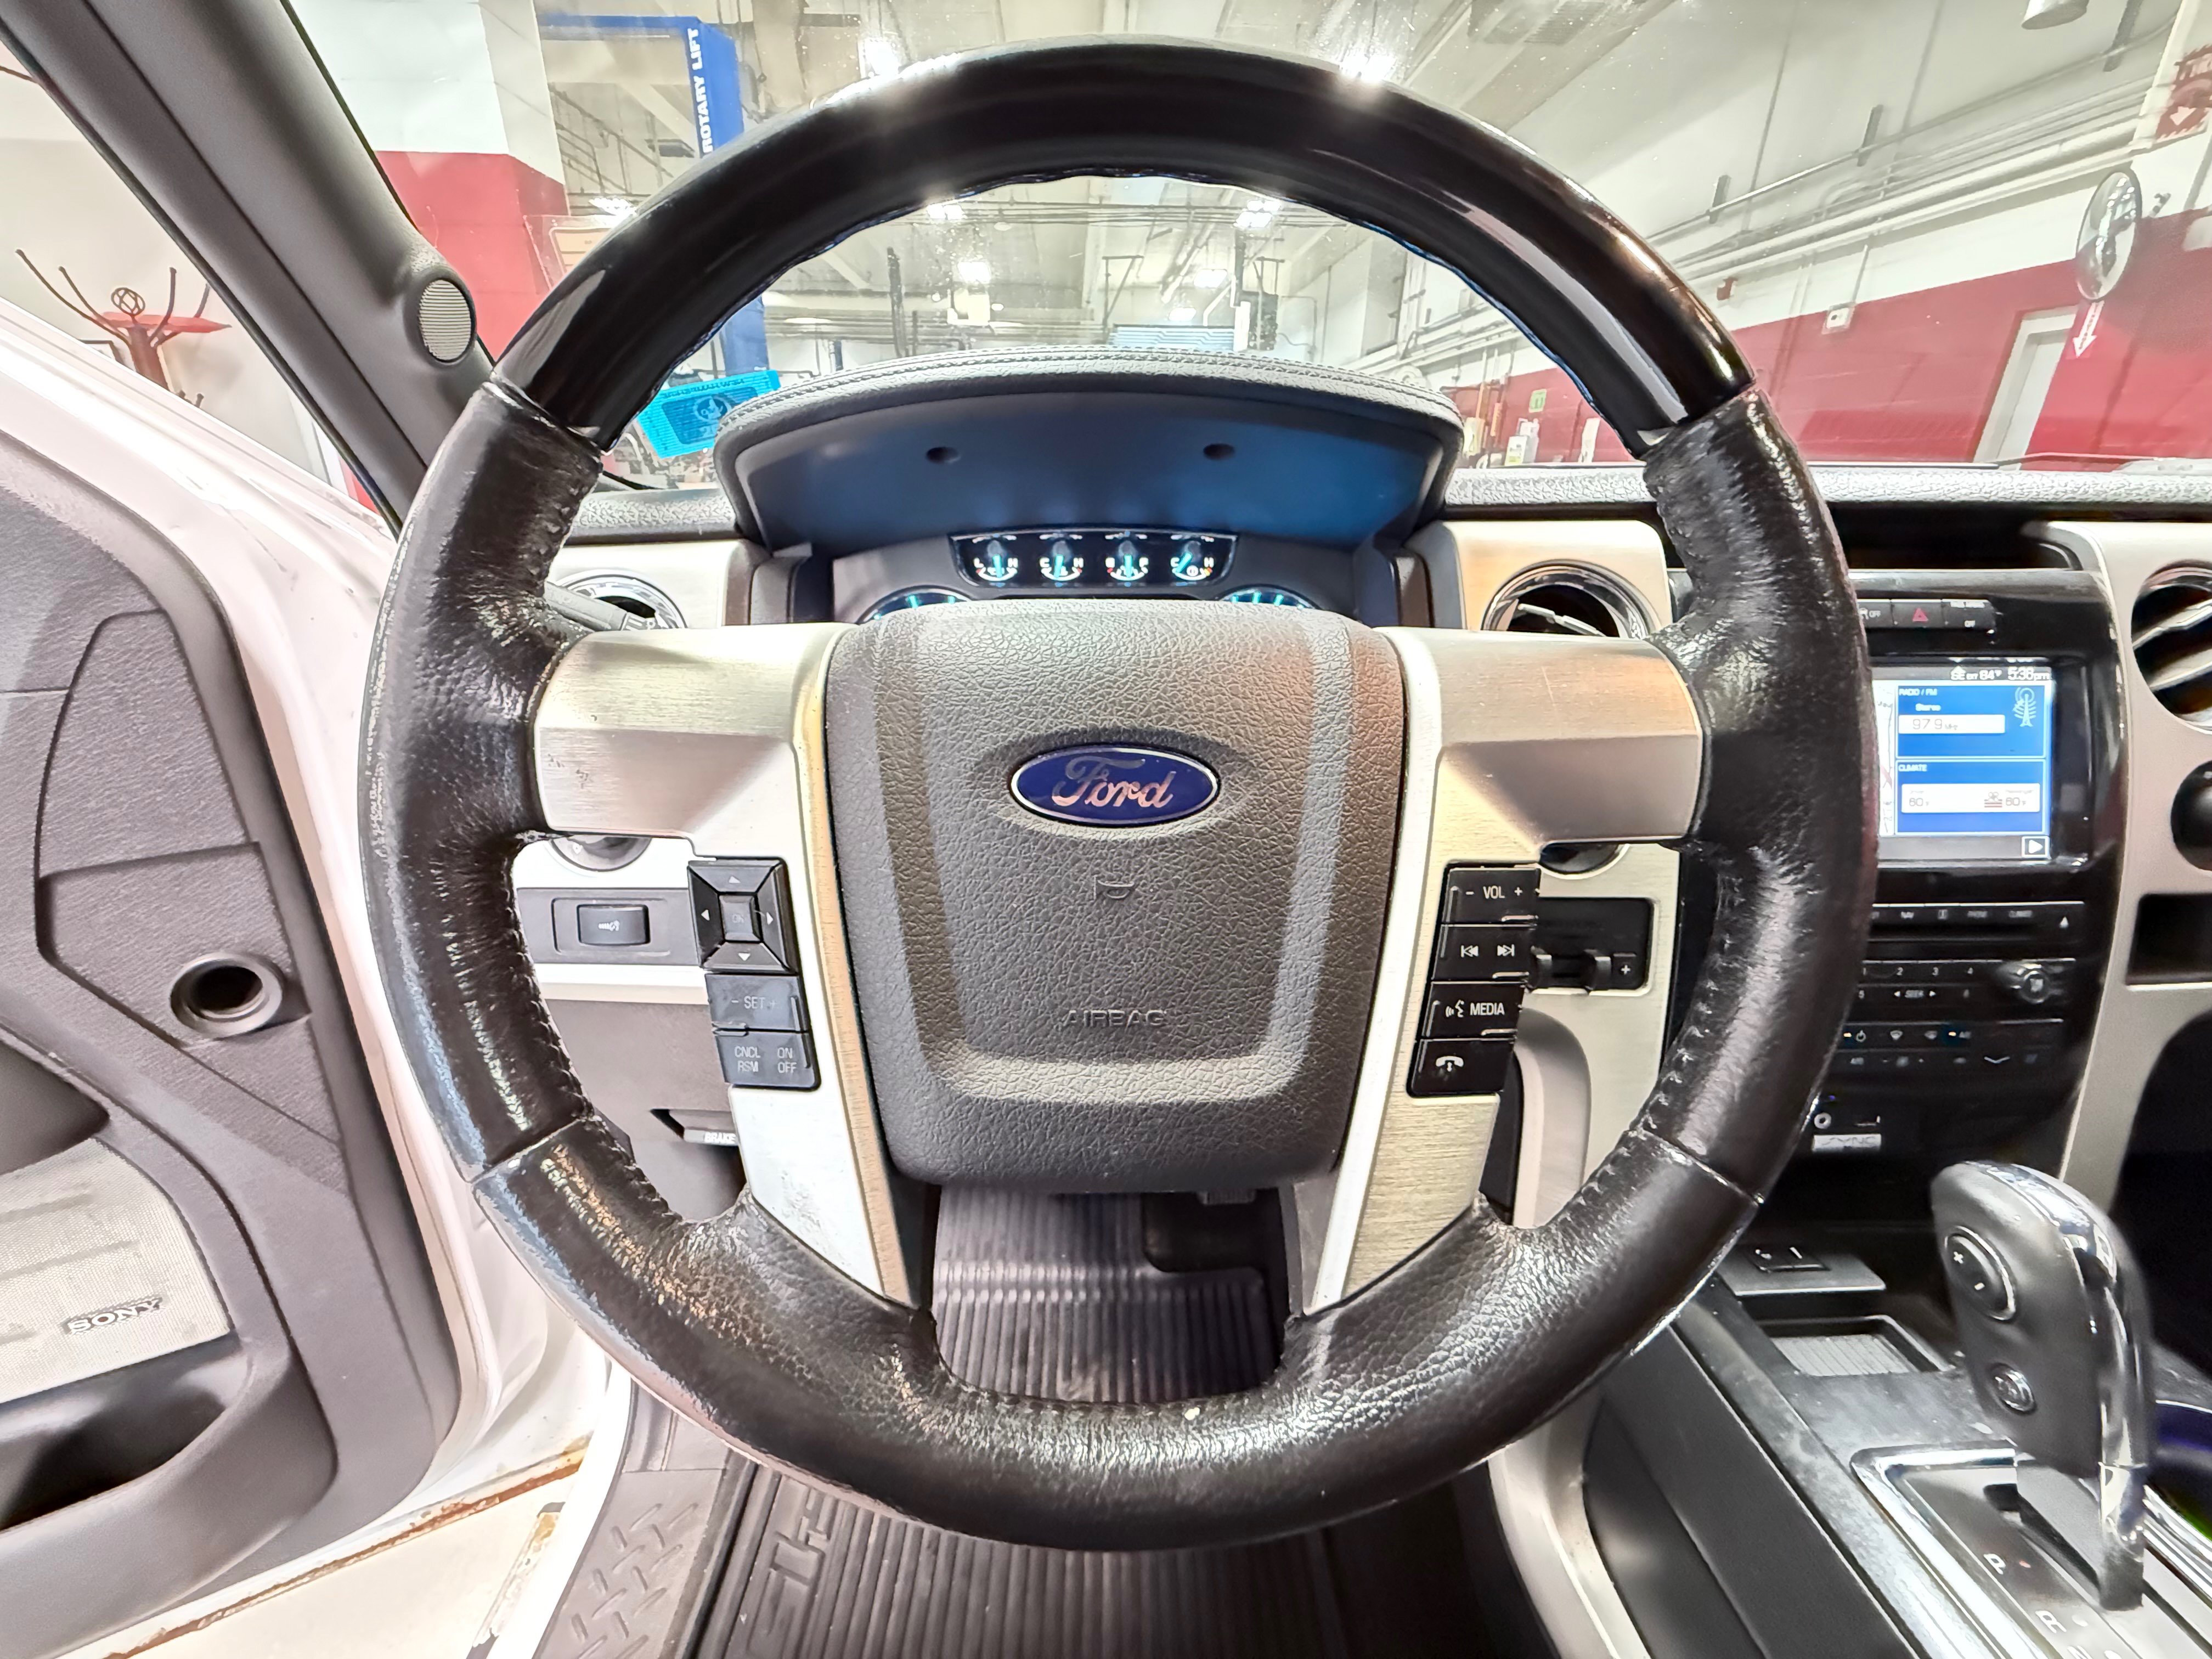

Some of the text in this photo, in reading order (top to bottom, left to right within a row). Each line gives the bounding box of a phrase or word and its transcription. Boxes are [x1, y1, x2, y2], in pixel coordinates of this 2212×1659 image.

[687, 28, 713, 153] ROTARY LIFT
[1007, 557, 1018, 568] H
[1073, 557, 1084, 568] H
[1204, 557, 1214, 567] H
[1898, 764, 1928, 772] CLIMATE
[1052, 755, 1177, 808] Ford
[1483, 885, 1505, 899] VOL
[1897, 967, 1904, 975] 2
[1932, 967, 1939, 976] 3
[744, 996, 766, 1009] SET
[1470, 1002, 1505, 1015] MEDIA
[1062, 1009, 1167, 1027] AIRBAG
[734, 1046, 793, 1059] CNCL ON
[737, 1060, 797, 1073] RSM OFF
[704, 1132, 736, 1144] BRAKE
[66, 1297, 163, 1332] SONY
[1983, 1553, 2006, 1575] P
[2035, 1610, 2067, 1633] R
